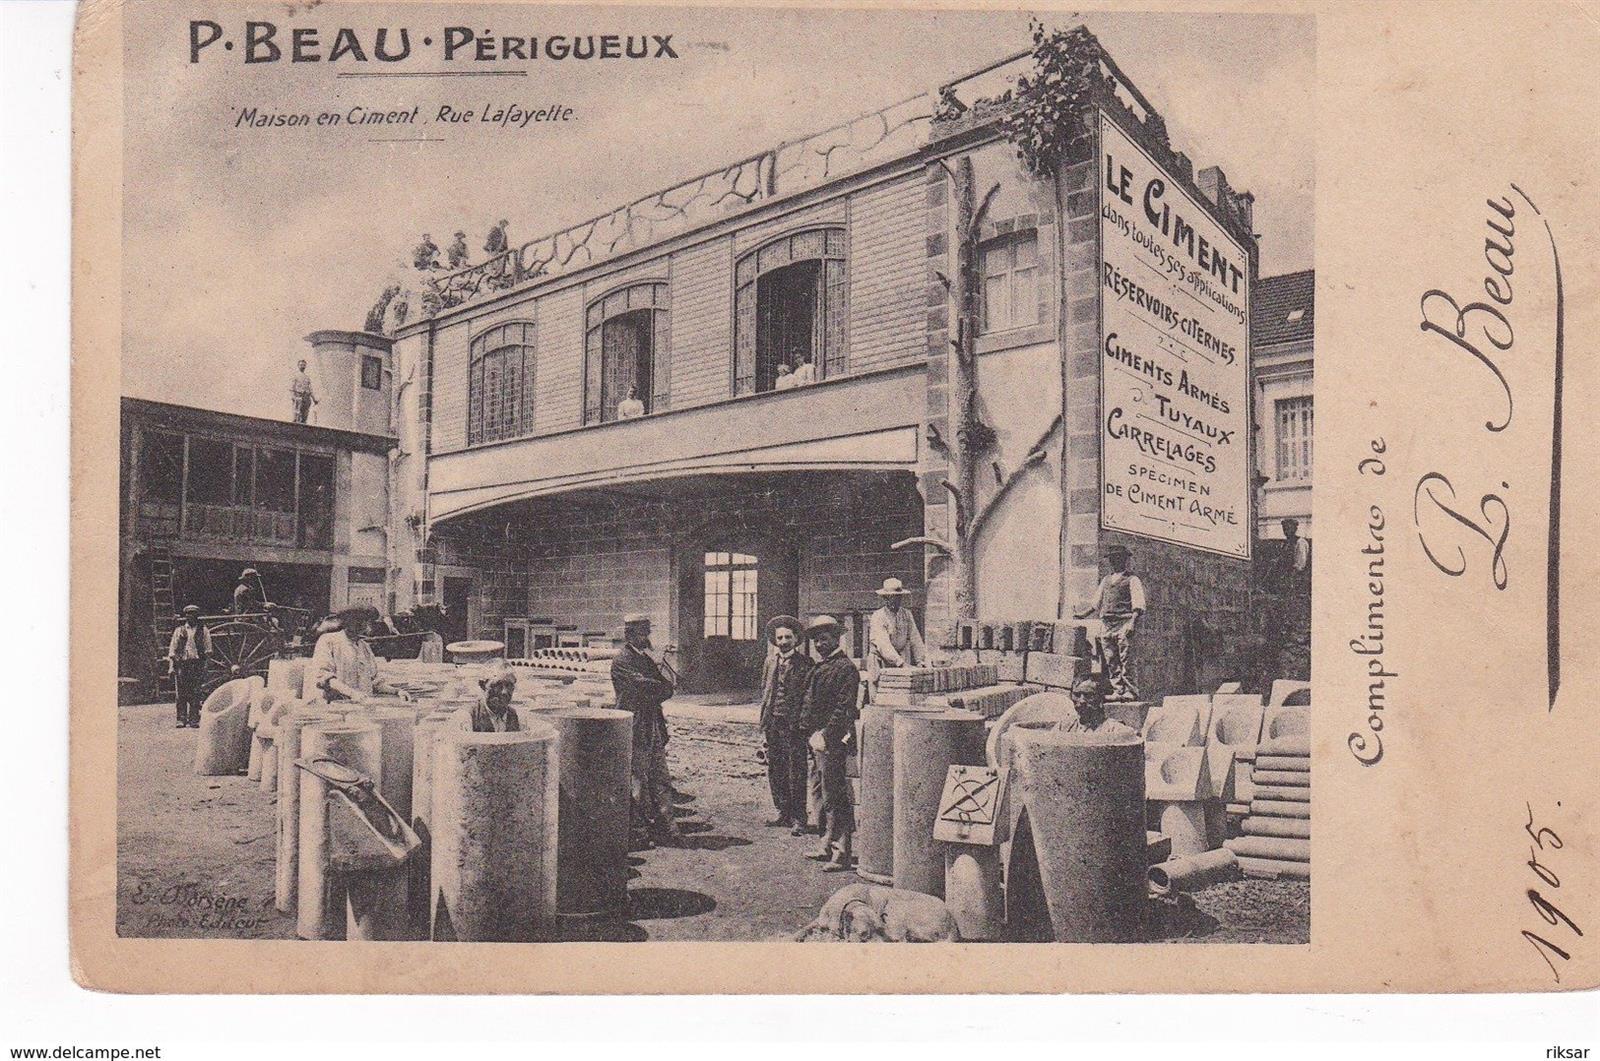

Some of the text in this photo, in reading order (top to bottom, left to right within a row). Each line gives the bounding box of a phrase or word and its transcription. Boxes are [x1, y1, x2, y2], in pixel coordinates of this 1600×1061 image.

[443, 26, 679, 62] PÉRIGUEUX
[234, 107, 310, 128] Maison
[317, 112, 341, 126] en
[435, 105, 473, 124] Rue
[1106, 154, 1243, 294] LE CIMENT
[1102, 202, 1245, 325] dans toutes ses applications
[1420, 196, 1516, 432] Beau
[1105, 332, 1231, 414] CIMENTS ARMÉS
[1107, 407, 1216, 473] CARRELAGES
[1155, 393, 1235, 445] TUYAUX
[1128, 464, 1211, 496] SPÉCIMEN
[1358, 437, 1386, 475] de
[1106, 483, 1238, 526] DE CIMENT ARMÉ
